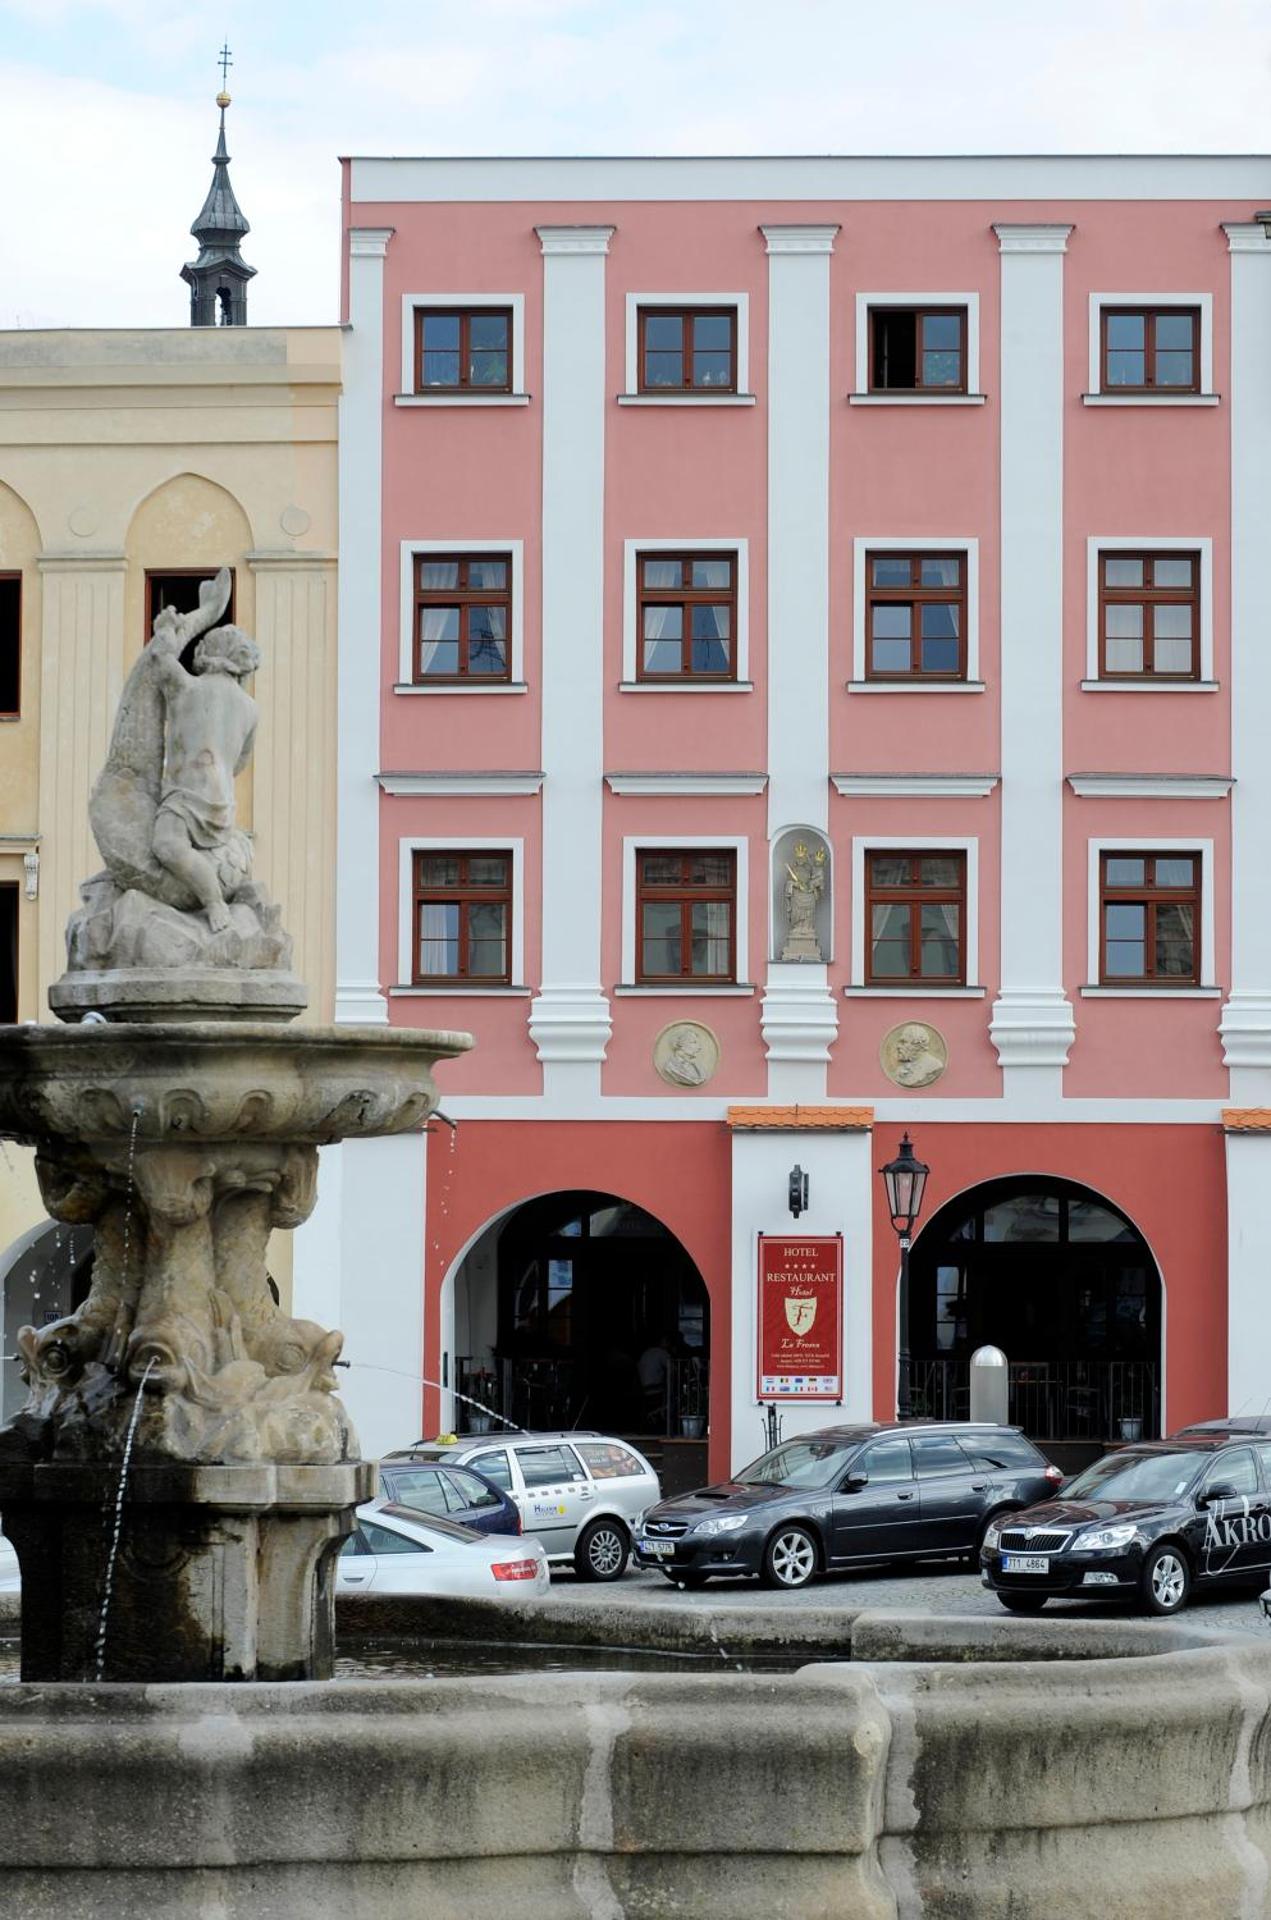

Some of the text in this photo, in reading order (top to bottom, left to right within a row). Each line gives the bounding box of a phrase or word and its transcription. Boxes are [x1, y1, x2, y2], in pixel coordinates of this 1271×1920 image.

[783, 1247, 819, 1257] HOTEL
[766, 1272, 836, 1282] RESTAURANT
[789, 1285, 813, 1296] Hotel
